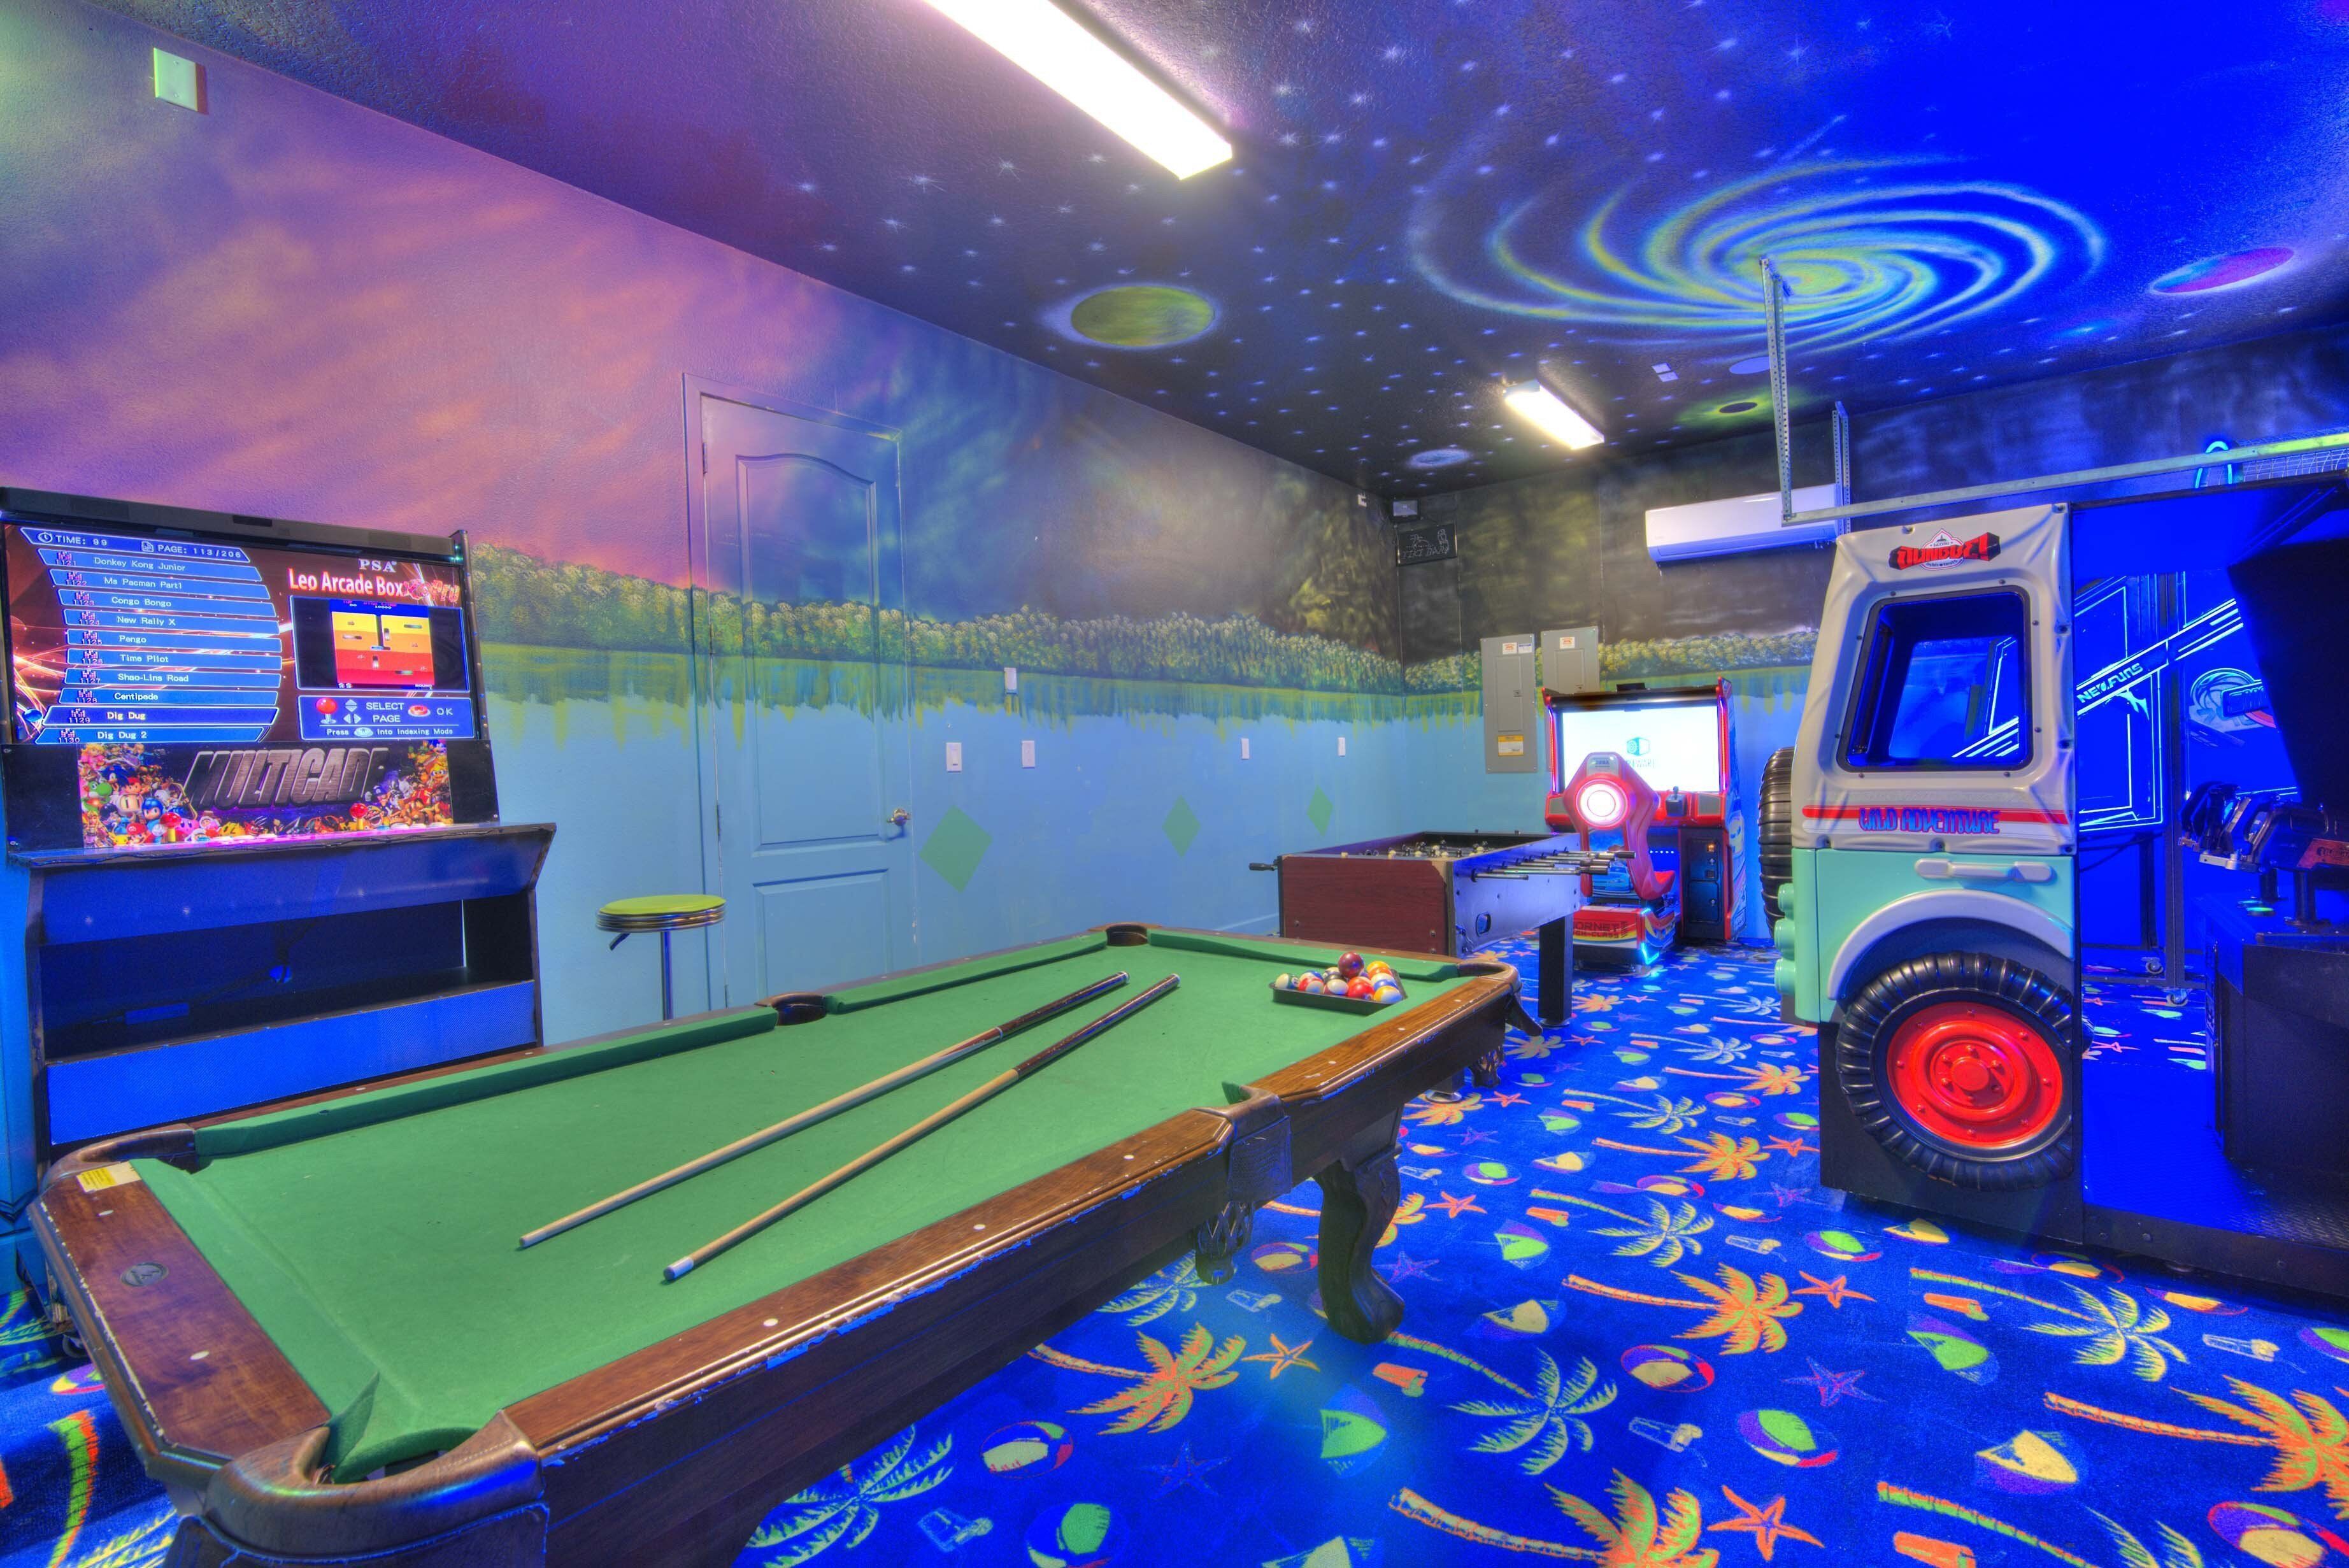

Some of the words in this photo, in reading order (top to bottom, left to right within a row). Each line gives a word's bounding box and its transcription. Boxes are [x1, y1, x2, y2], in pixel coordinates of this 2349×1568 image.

[55, 534, 86, 545] TIME:
[92, 538, 108, 546] 99
[158, 544, 187, 555] PAGE:
[94, 557, 127, 567] Donkey
[132, 560, 154, 570] Kong
[159, 563, 186, 571] Junior
[104, 576, 118, 585] Ms
[122, 578, 156, 588] Pacman
[288, 567, 318, 591] Leo
[321, 571, 374, 596] Arcade
[375, 576, 404, 597] Box
[111, 596, 139, 606] Congo
[145, 599, 171, 608] Bongo
[117, 615, 136, 624] New
[141, 617, 164, 626] Rally
[118, 634, 147, 644] Pengo
[120, 653, 142, 662] Time
[146, 655, 169, 663] Pilot
[117, 673, 162, 681] Shao-Lins
[114, 692, 159, 701] Centipede
[366, 702, 404, 711] SELECT
[106, 711, 124, 720] Dig
[128, 712, 146, 720] Dug
[436, 708, 453, 716] OK
[372, 715, 401, 723] PAGE
[97, 731, 114, 740] Dig
[118, 731, 136, 740] Dug
[141, 731, 147, 739] 2
[1859, 807, 1898, 832] WILD
[1899, 807, 2001, 834] ADVENTURE
[1573, 921, 1620, 933] ORNET
